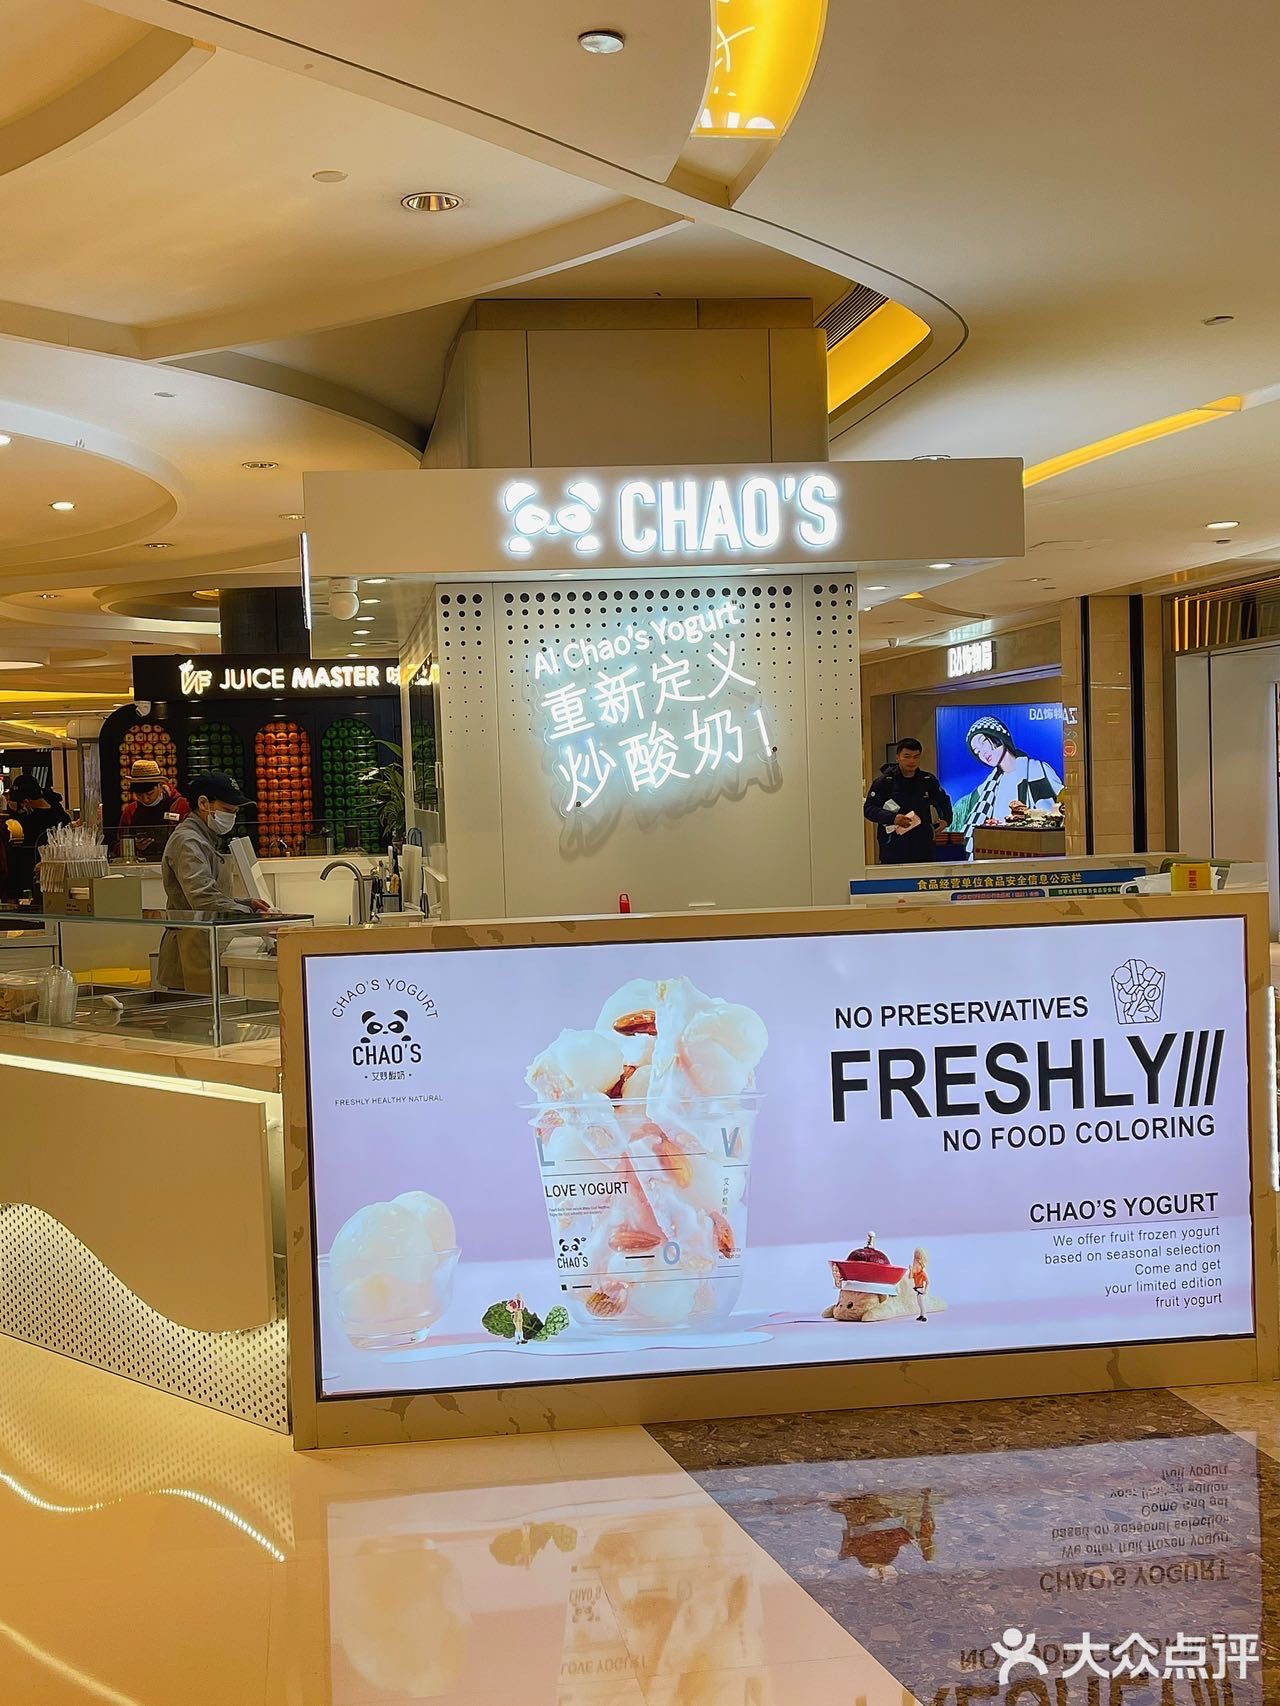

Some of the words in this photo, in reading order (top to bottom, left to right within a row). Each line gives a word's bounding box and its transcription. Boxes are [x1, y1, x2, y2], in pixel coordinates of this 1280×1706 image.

[619, 475, 837, 553] CHAO'S
[563, 624, 650, 669] Chao's
[650, 601, 741, 645] Yogurt
[219, 667, 285, 690] JUICE
[291, 664, 380, 689] MASTER
[541, 640, 757, 740] 重新定义
[917, 872, 1082, 891] 食品经营单位食品安全信息公示栏
[332, 979, 380, 1018] CHAO'S
[386, 978, 438, 1019] YOGURT
[834, 1006, 873, 1029] NO
[881, 996, 1089, 1028] PRESERVATIVES
[353, 1043, 422, 1066] CHAO'S
[335, 1098, 369, 1107] FRESHLY
[372, 1096, 406, 1105] HEALTHY
[408, 1094, 443, 1103] NATURAL
[943, 1129, 981, 1152] NO
[991, 1123, 1066, 1150] FOOD
[1076, 1114, 1215, 1143] COLORING
[545, 1183, 577, 1199] LOVE
[579, 1181, 629, 1197] YOGURT
[1030, 1199, 1117, 1223] CHAO'S
[1123, 1192, 1219, 1217] YOGURT
[1053, 1234, 1073, 1247] We
[1078, 1232, 1106, 1246] offer
[1110, 1231, 1135, 1244] fruit
[1138, 1229, 1177, 1243] frozen
[1181, 1225, 1221, 1241] yogurt
[557, 1255, 589, 1269] CHAO'S
[1045, 1251, 1082, 1265] based
[1087, 1251, 1102, 1261] on
[1106, 1246, 1162, 1261] seasonal
[1166, 1242, 1221, 1256] selection
[1135, 1263, 1171, 1276] Come
[1175, 1260, 1197, 1273] and
[1202, 1259, 1222, 1275] get
[1105, 1284, 1132, 1297] your
[1136, 1278, 1177, 1292] limited
[1181, 1275, 1222, 1290] edition
[1155, 1296, 1180, 1308] fruit
[1184, 1293, 1223, 1309] yogurt
